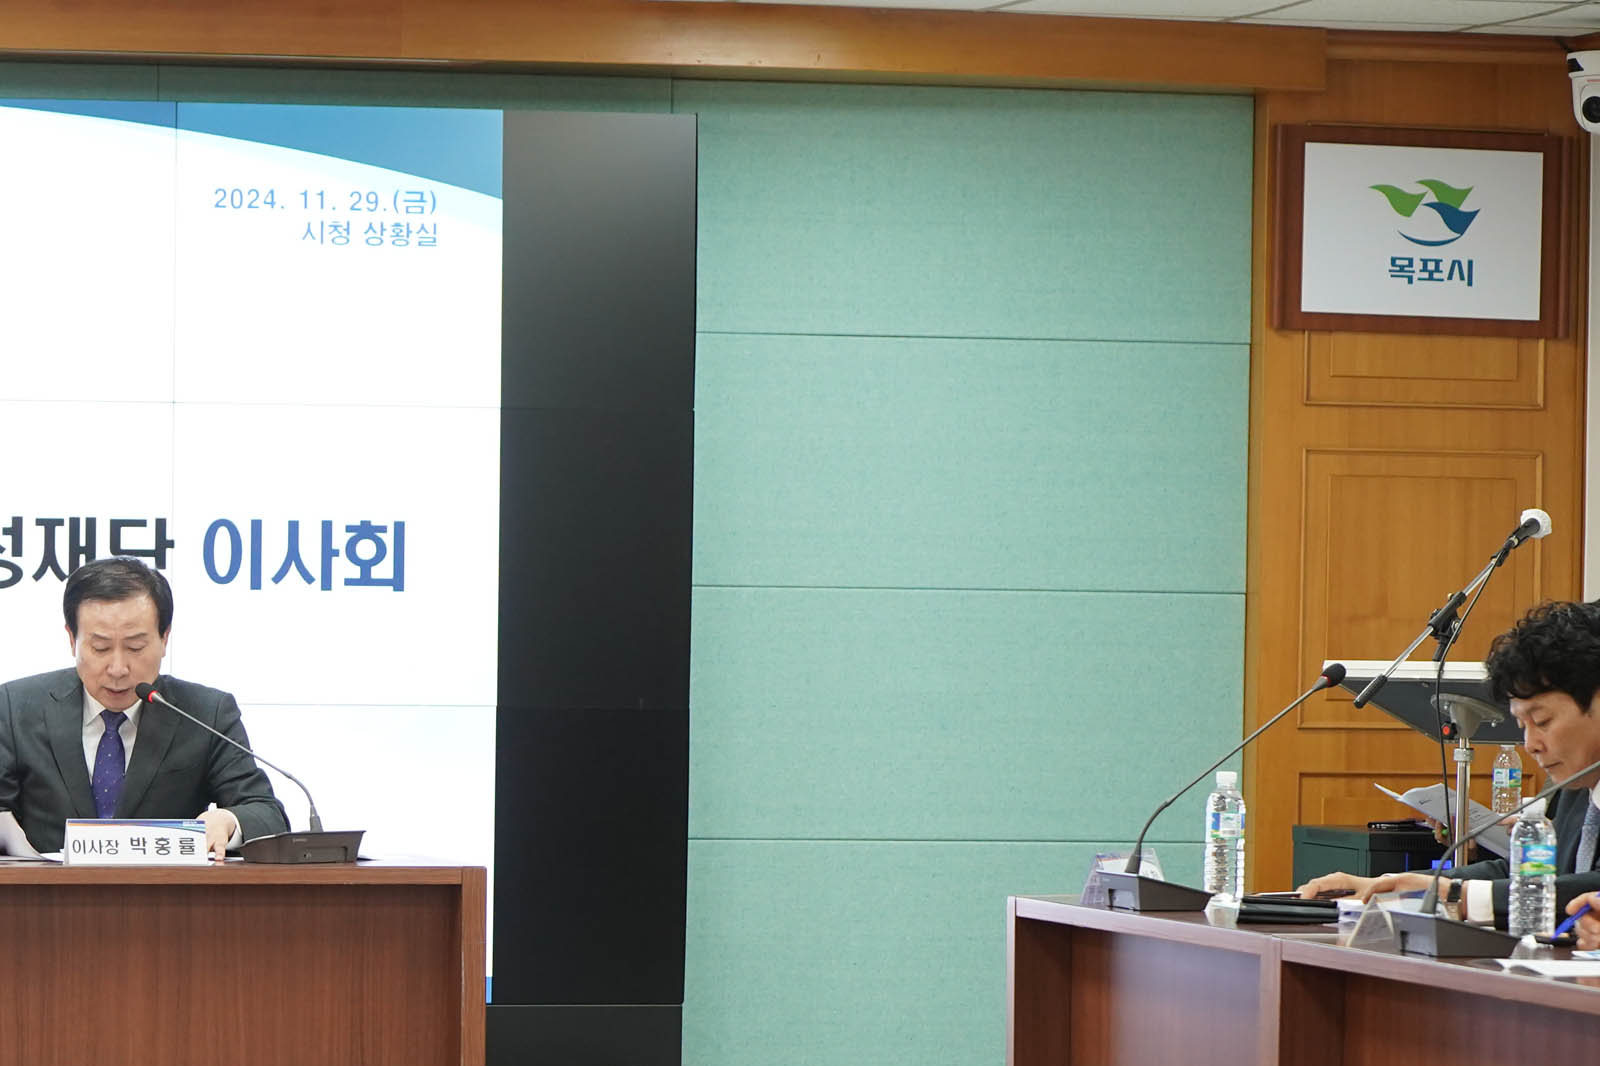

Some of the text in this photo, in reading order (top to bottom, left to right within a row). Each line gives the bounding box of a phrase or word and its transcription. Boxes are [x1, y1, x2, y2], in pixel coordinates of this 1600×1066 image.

[213, 187, 438, 215] 2024. 11. 29.(금)
[302, 221, 438, 248] 시청 상황실
[1388, 256, 1474, 287] 목포시
[202, 518, 406, 593] 이사회
[72, 839, 119, 856] 이사장
